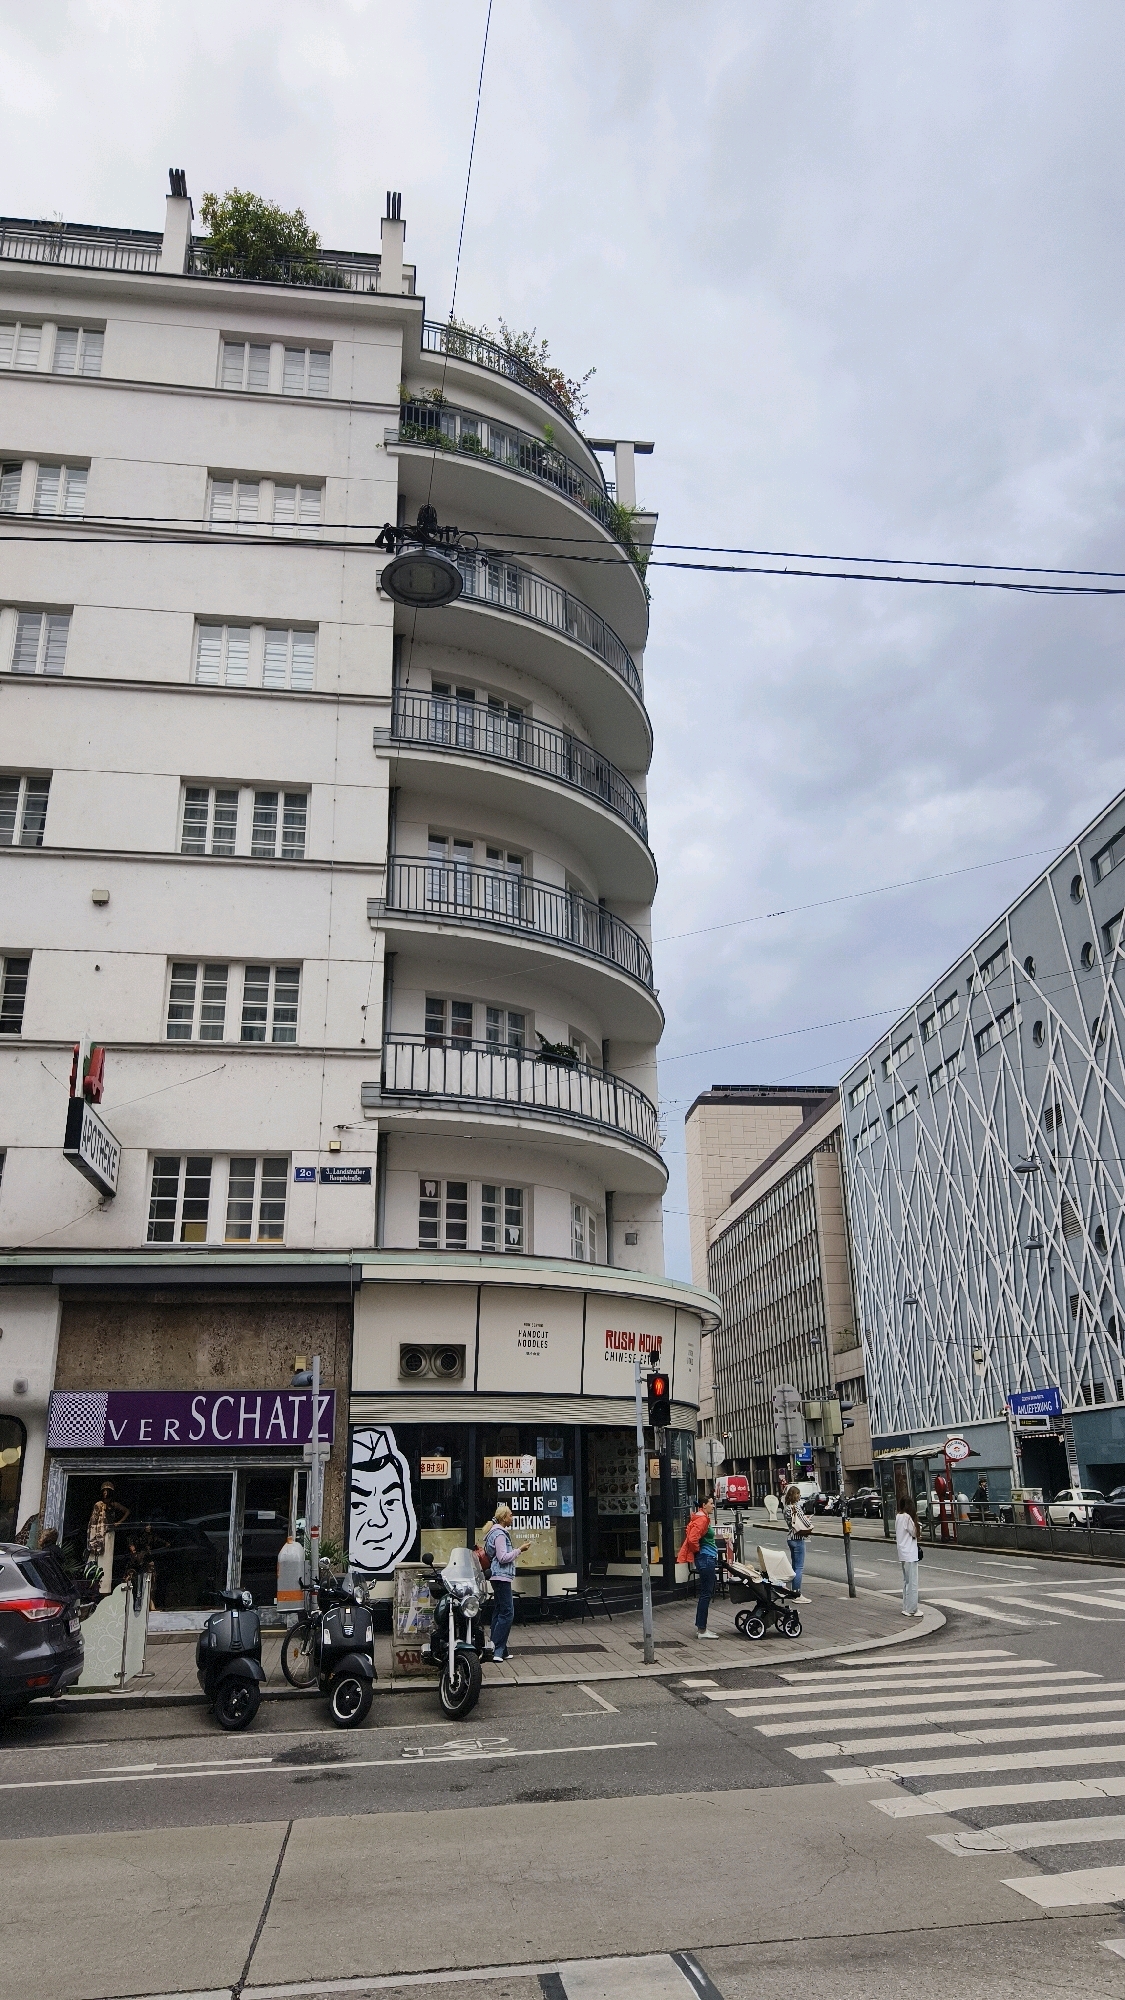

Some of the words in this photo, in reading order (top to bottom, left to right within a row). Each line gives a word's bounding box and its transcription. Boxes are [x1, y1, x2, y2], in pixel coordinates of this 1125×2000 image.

[81, 1115, 118, 1183] APOTHEKE
[333, 1168, 366, 1176] Landstraßer
[518, 1329, 549, 1339] HANDCUT
[605, 1329, 635, 1351] RUSH
[638, 1332, 663, 1354] HOUR
[517, 1339, 549, 1349] NOODLES
[604, 1351, 637, 1364] CHINESE
[640, 1354, 662, 1366] EATY
[495, 1459, 514, 1469] RUSH
[497, 1477, 558, 1492] SOMETHING
[511, 1496, 530, 1511] BIG
[534, 1496, 544, 1511] IS
[505, 1515, 551, 1530] OOKING
